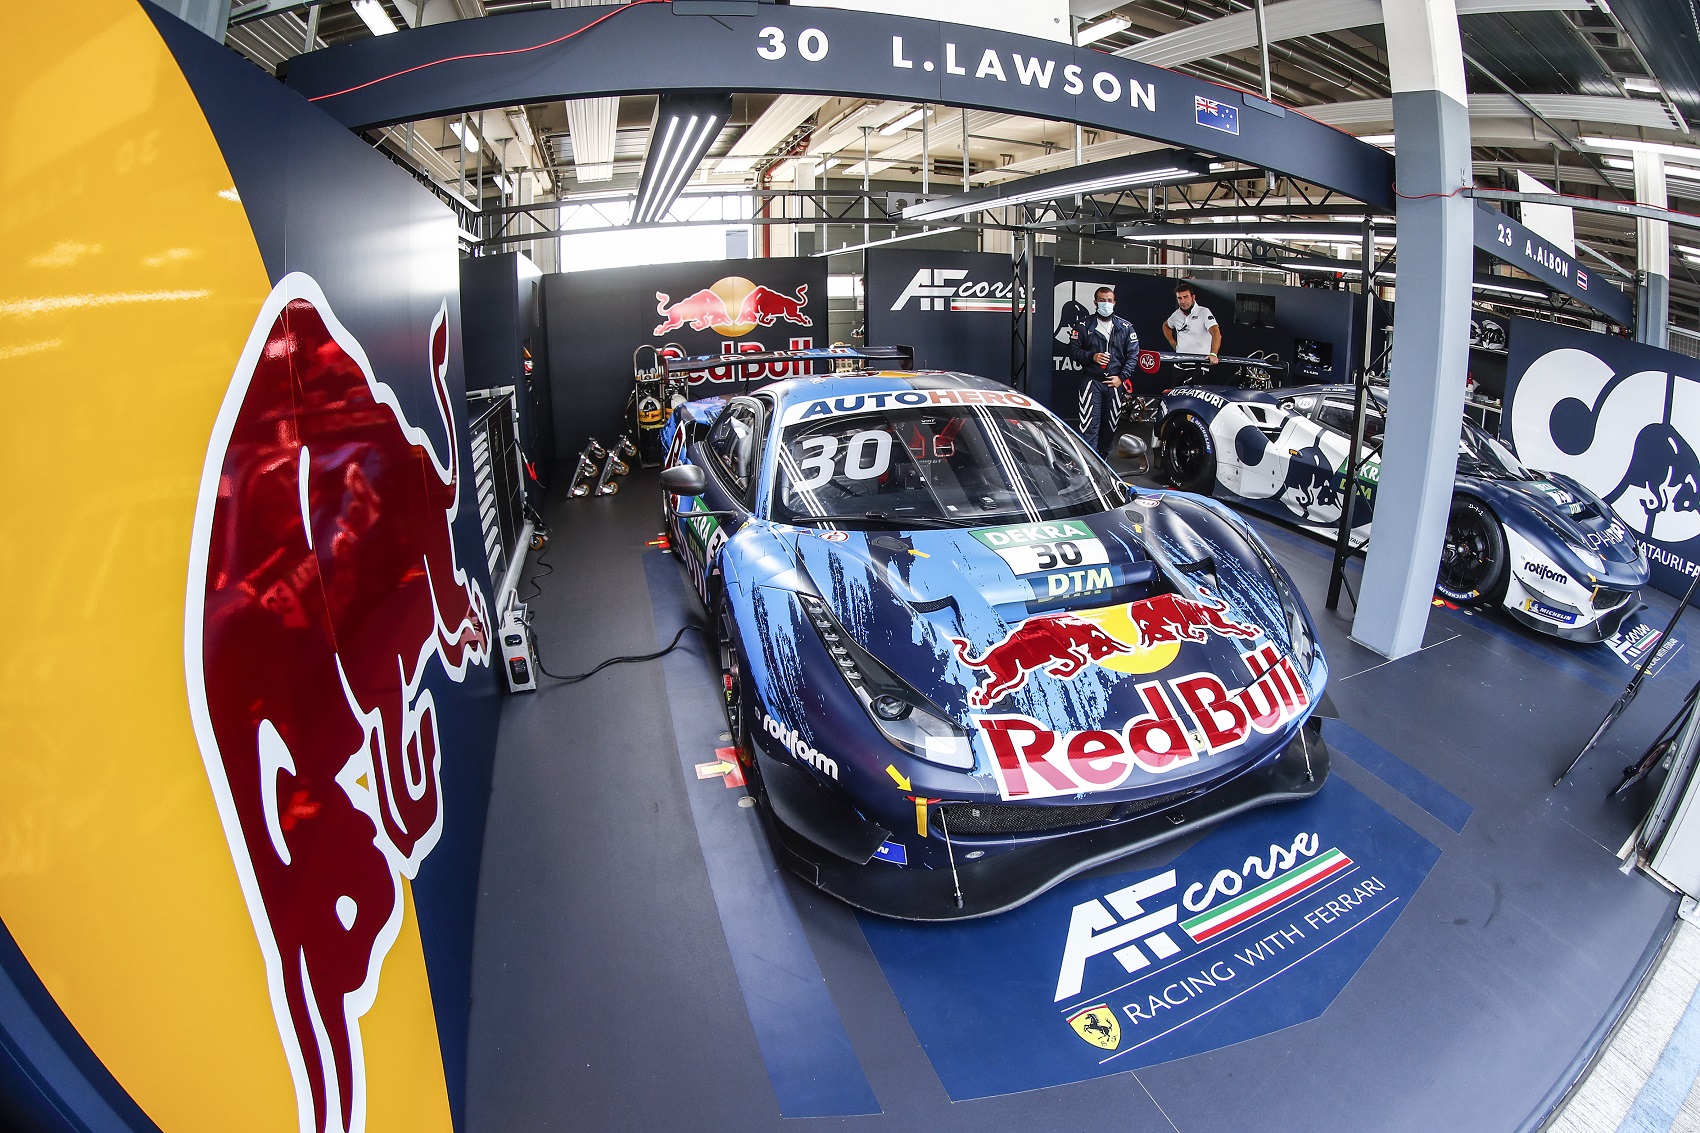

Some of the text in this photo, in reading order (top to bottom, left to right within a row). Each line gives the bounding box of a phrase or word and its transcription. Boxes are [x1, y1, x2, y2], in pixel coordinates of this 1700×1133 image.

[756, 26, 1158, 113] 30 L.LAWSON
[1497, 223, 1569, 279] 23 A.ALBON
[799, 390, 1032, 420] AUTOHERO
[1167, 387, 1225, 409] ALPHATAURI
[796, 429, 893, 492] 30
[985, 523, 1088, 547] DEKRA
[1029, 541, 1084, 570] 30
[1046, 566, 1115, 598] DTM
[1523, 561, 1568, 585] rotiform
[1539, 607, 1572, 622] MICHELIN
[975, 643, 1308, 799] Red Bull
[763, 713, 840, 781] rotiform
[1054, 831, 1321, 1004] AF corse
[1121, 875, 1387, 1026] RACING WITH FERRARI
